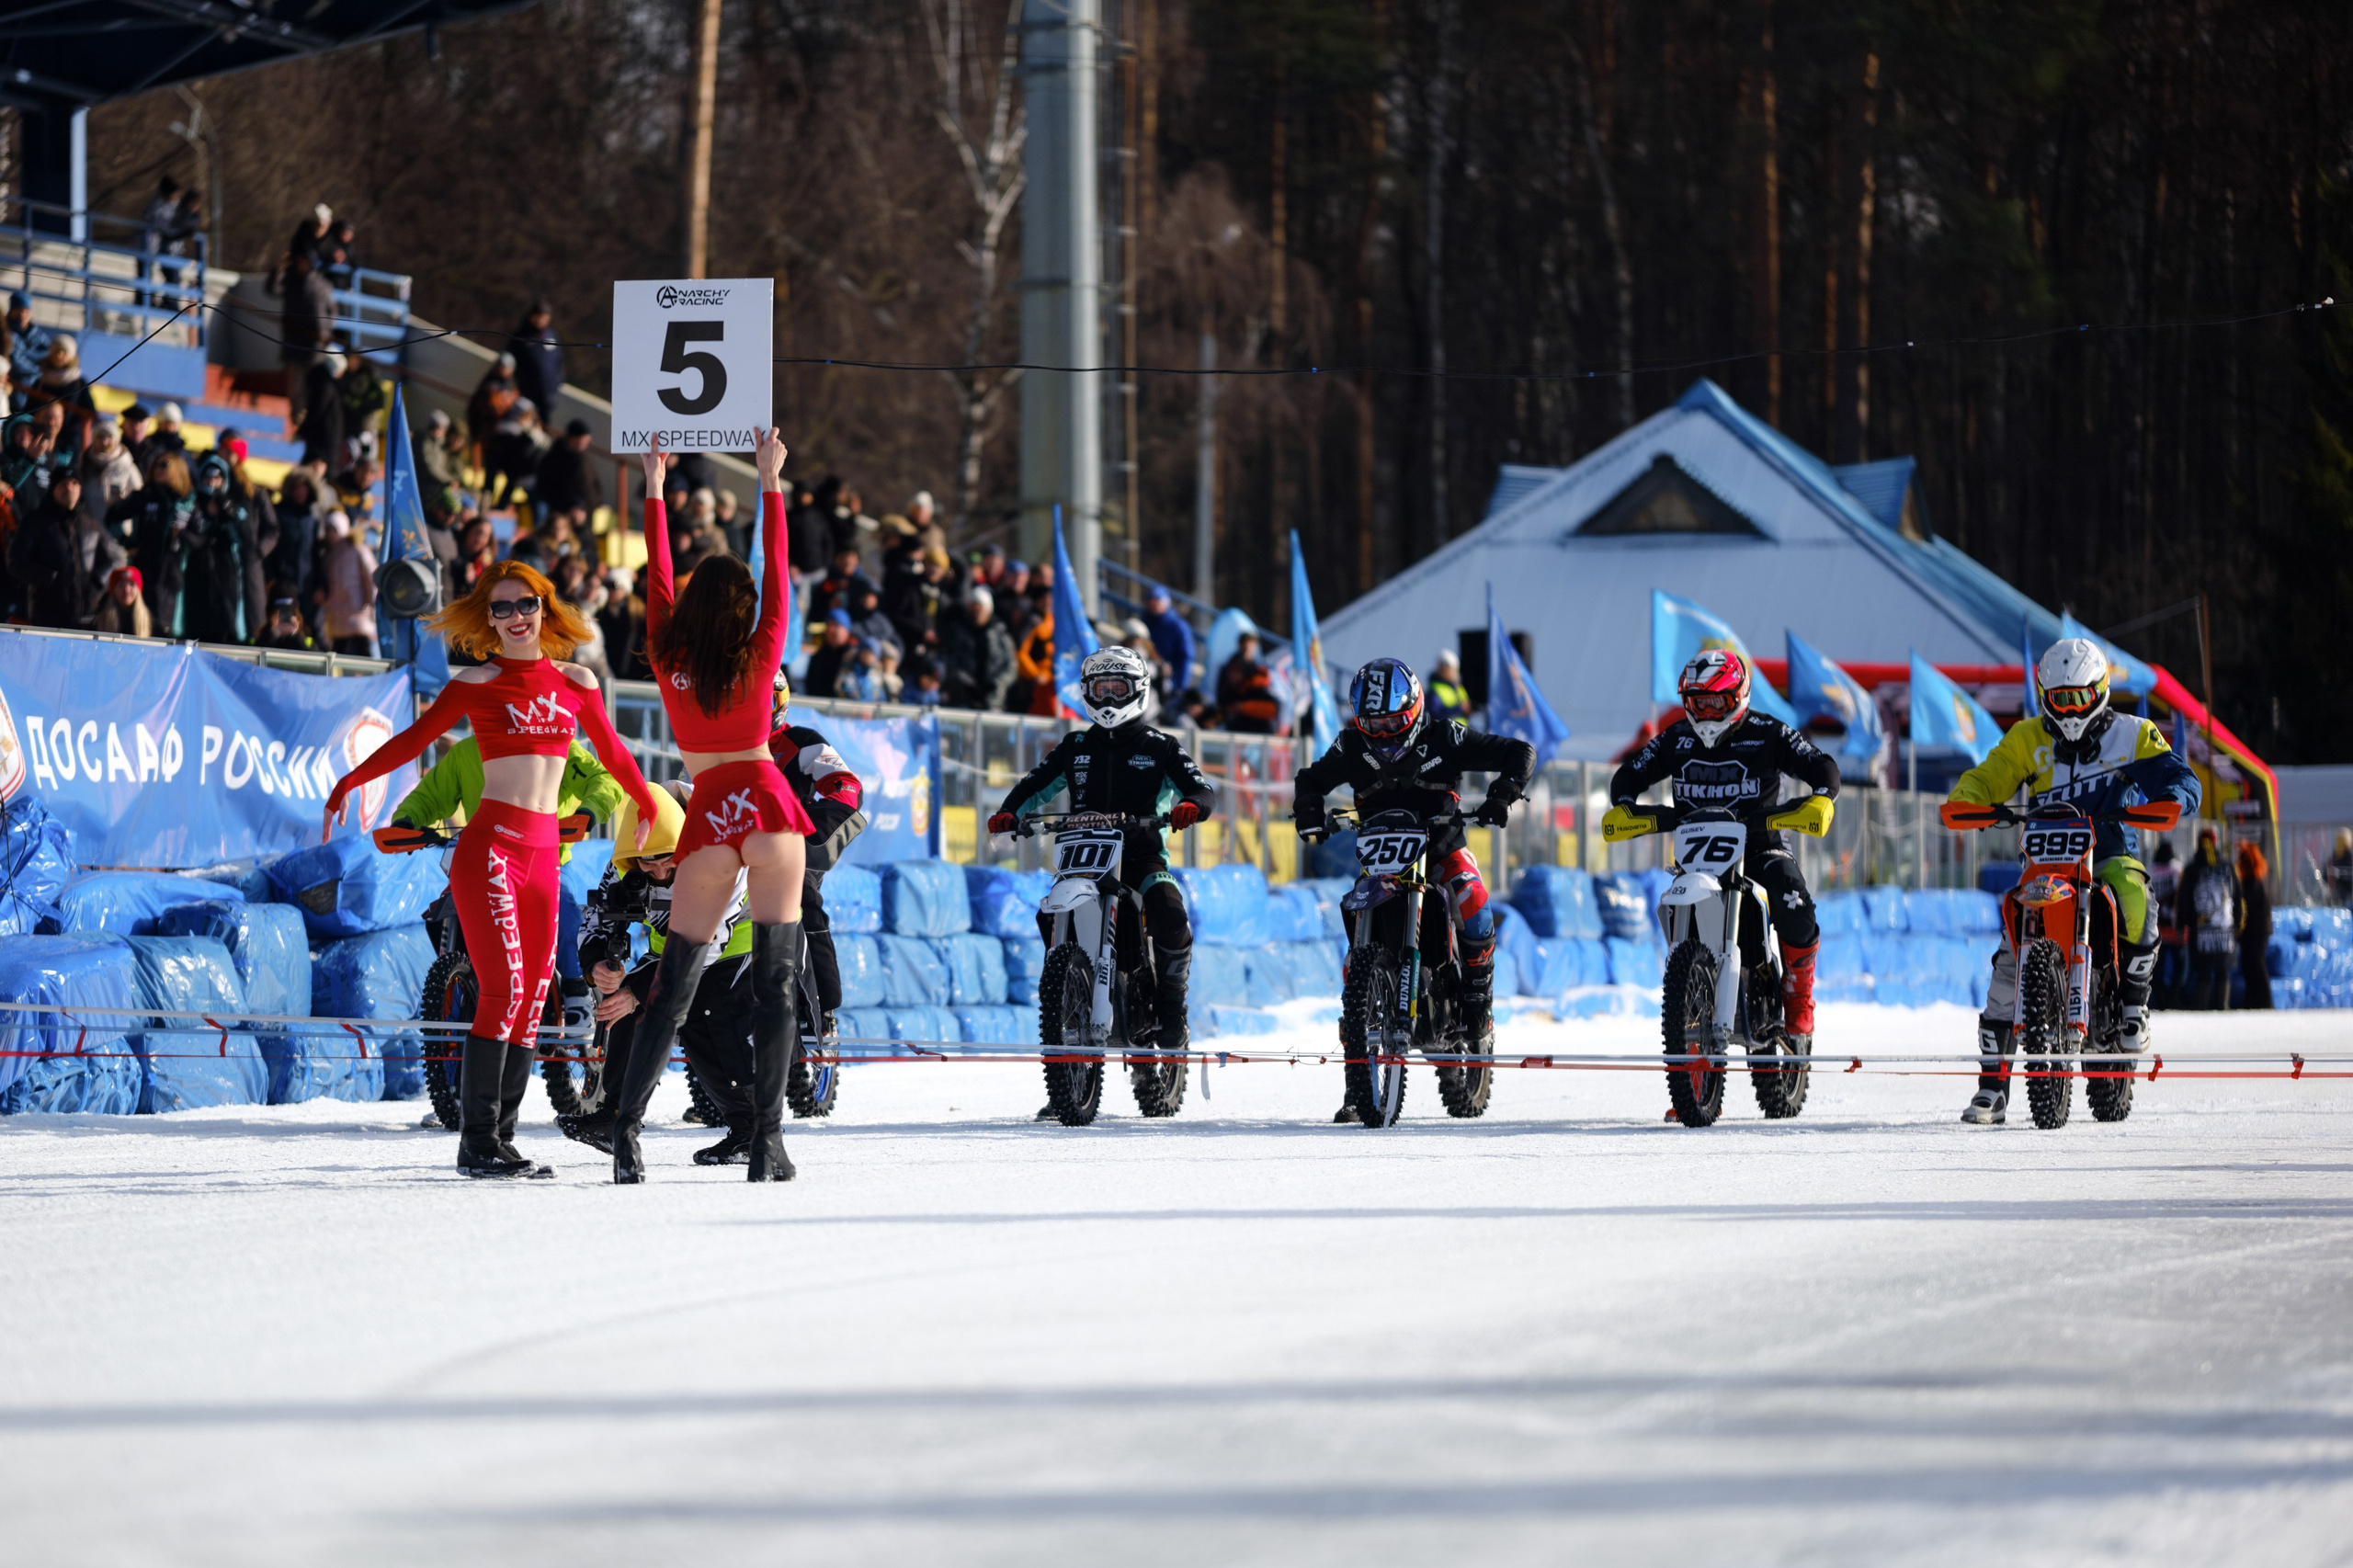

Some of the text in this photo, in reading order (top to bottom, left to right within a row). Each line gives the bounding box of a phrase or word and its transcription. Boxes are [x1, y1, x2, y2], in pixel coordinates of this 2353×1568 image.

[678, 297, 724, 306] RACING
[656, 321, 727, 415] 5
[621, 431, 651, 447] MX
[1088, 663, 1131, 673] HOUSE
[1366, 670, 1386, 710] FXR
[505, 690, 573, 729] MX
[1676, 736, 1696, 749] 76
[27, 715, 336, 801] ДОСААФ РОССИИ
[1689, 766, 1739, 782] MX
[1675, 779, 1757, 799] TIKHON
[705, 787, 758, 835] MX
[1617, 823, 1647, 832] Husqvarna
[1680, 826, 1706, 835] GUSEV
[1059, 842, 1116, 871] 101
[1360, 837, 1421, 866] 250
[1681, 835, 1739, 865] 76
[2026, 832, 2091, 857] 899
[2070, 986, 2082, 1017] ЦБИ
